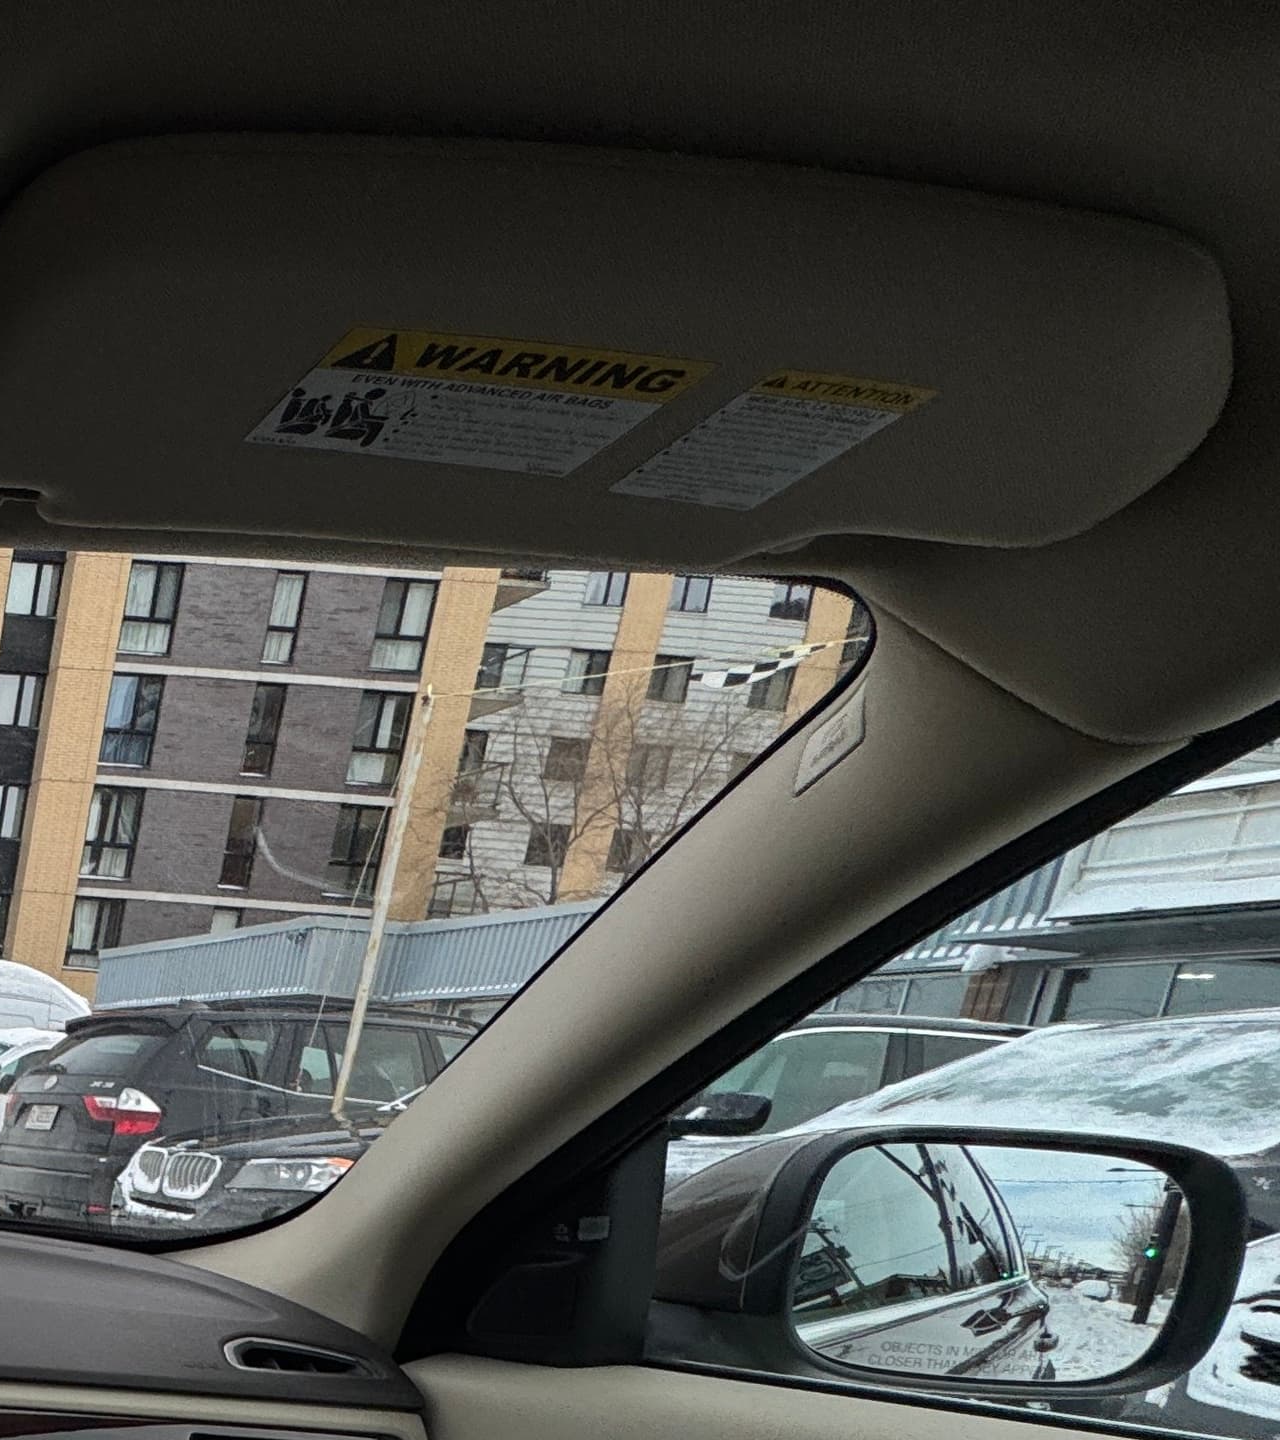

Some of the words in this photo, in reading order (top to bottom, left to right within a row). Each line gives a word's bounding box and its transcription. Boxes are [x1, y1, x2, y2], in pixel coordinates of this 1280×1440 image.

[415, 341, 685, 394] WARNING
[351, 373, 398, 386] EVEN
[397, 376, 443, 391] WITH
[443, 380, 534, 401] ADVANCED
[534, 389, 564, 403] AIR
[566, 393, 613, 411] BAGS
[791, 379, 913, 406] ATTENTION
[866, 1355, 922, 1369] CLOSER
[879, 1340, 944, 1357] OBJECTS
[945, 1343, 960, 1357] IN
